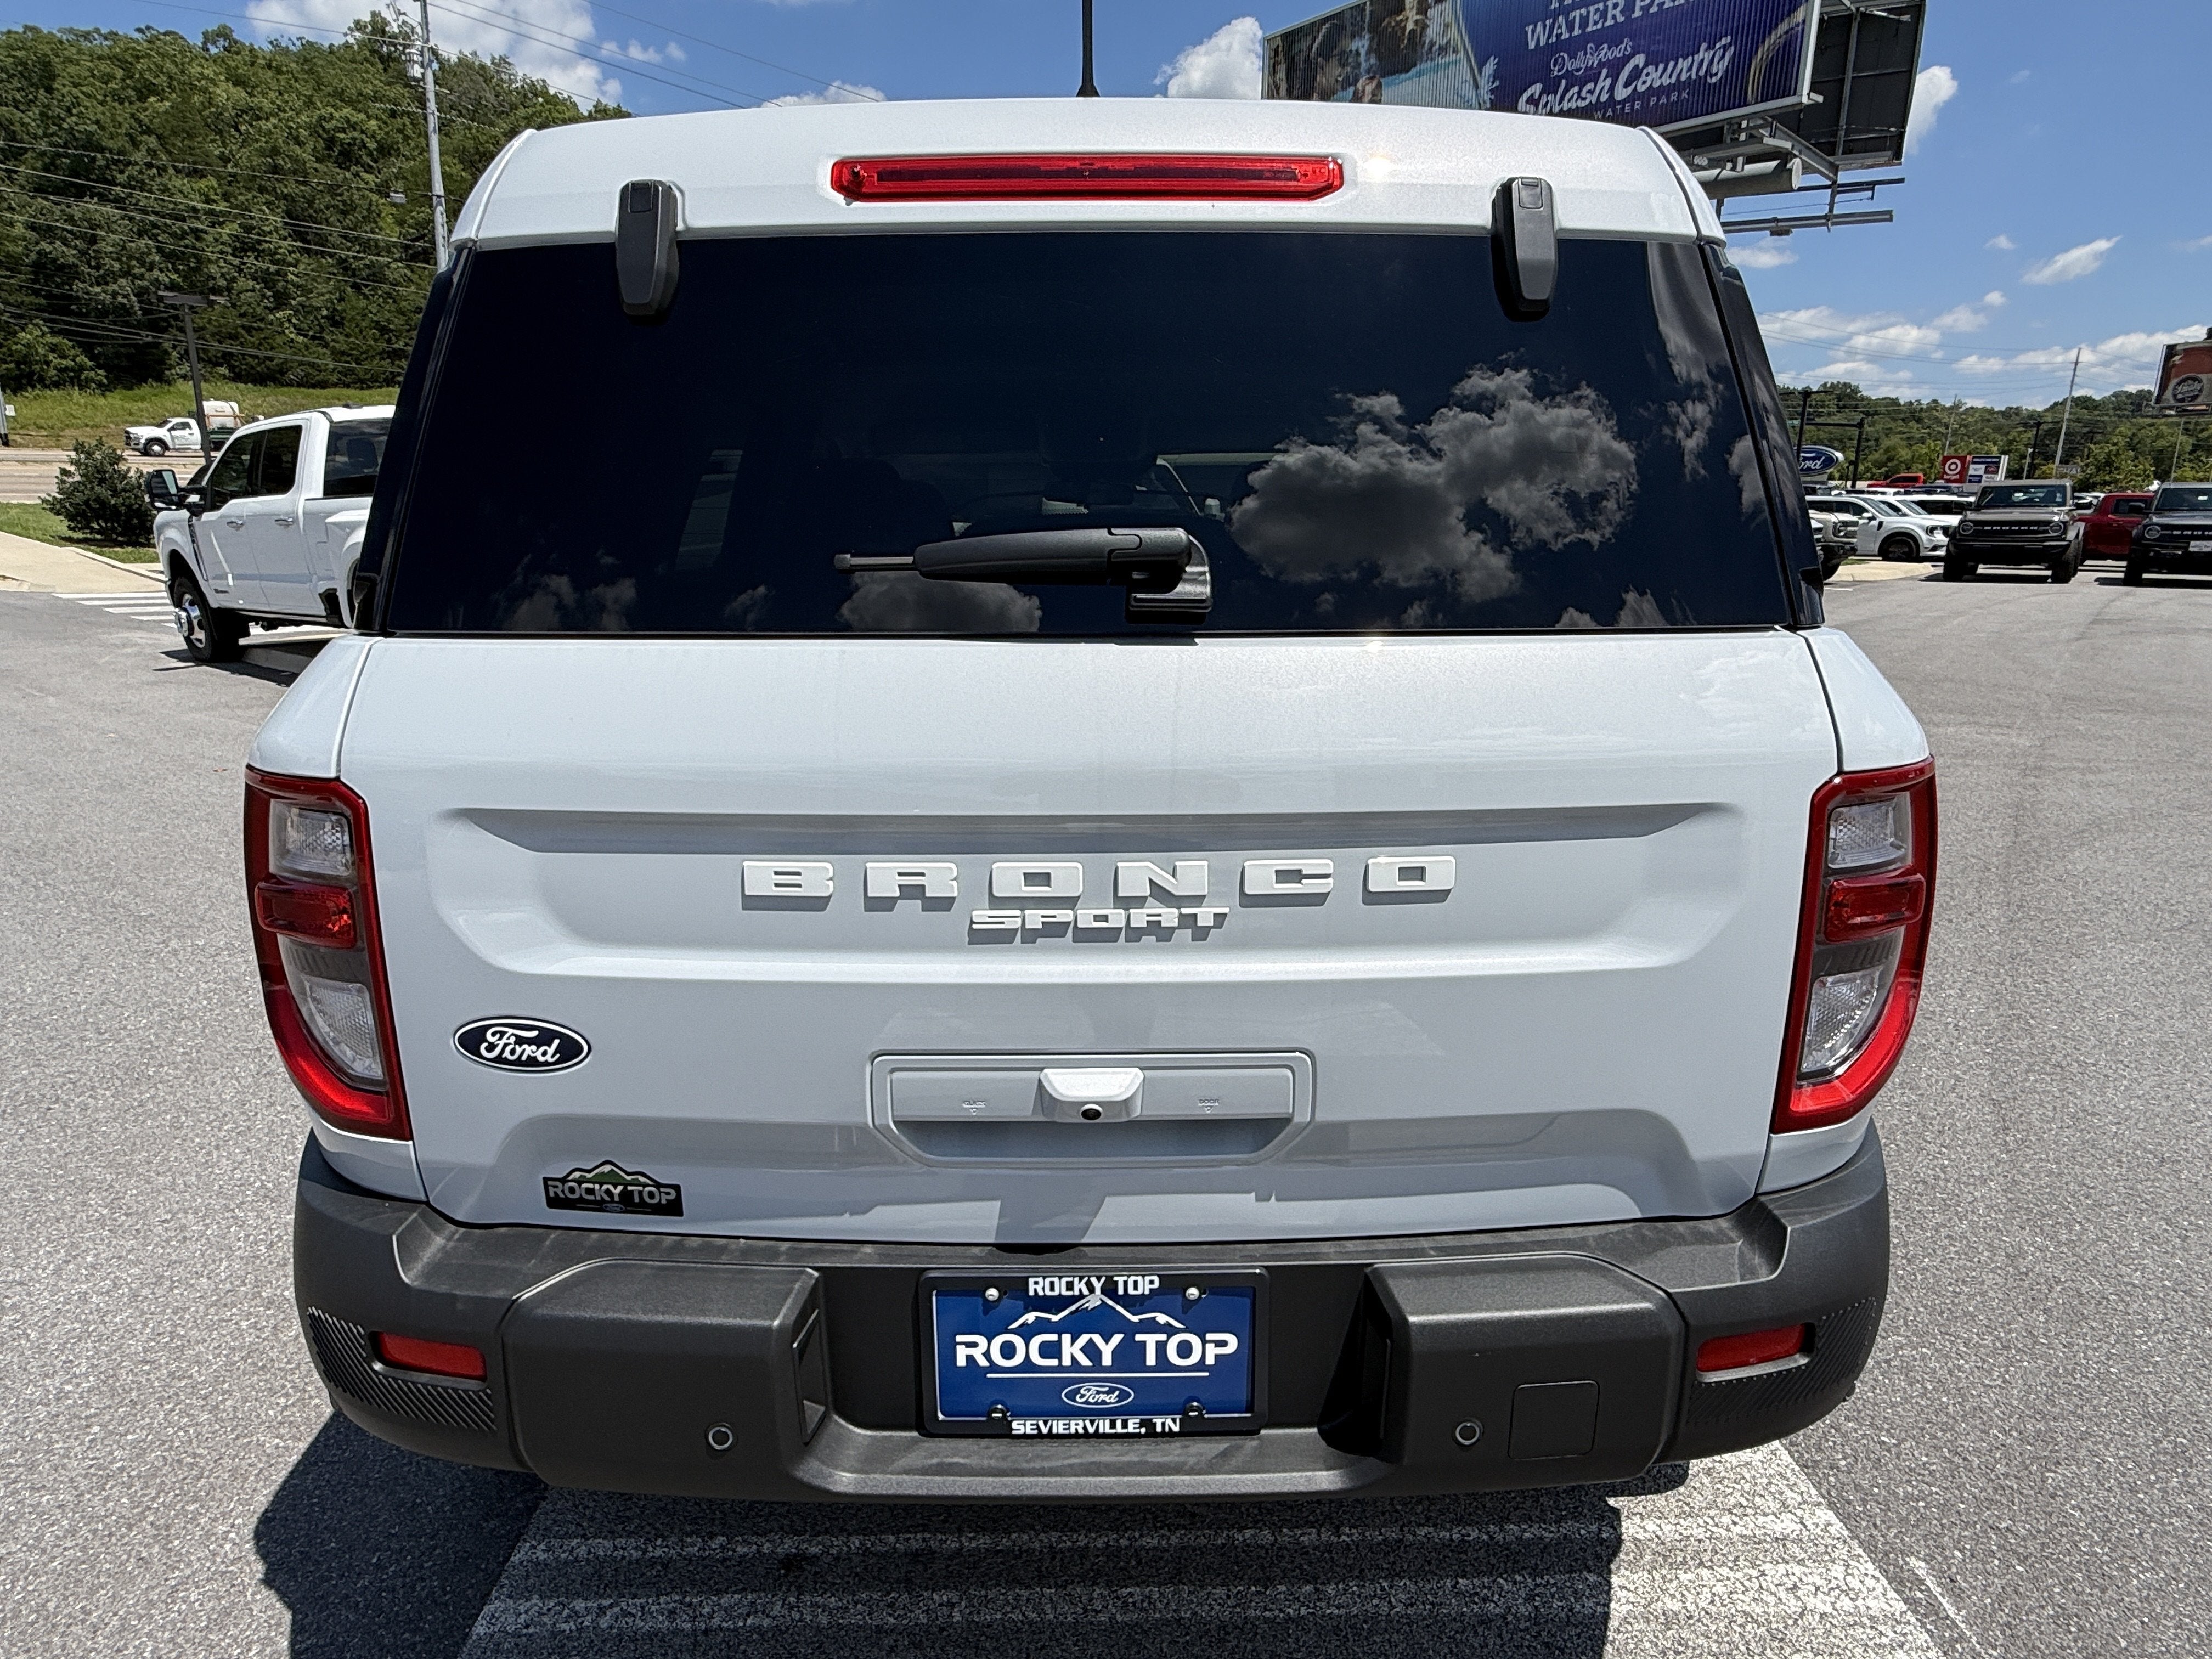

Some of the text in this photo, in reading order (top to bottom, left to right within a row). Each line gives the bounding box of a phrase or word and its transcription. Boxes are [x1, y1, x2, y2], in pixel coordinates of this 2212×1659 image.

[1525, 0, 1625, 49] WATER
[1517, 36, 1735, 115] Splash Country
[1594, 89, 1689, 120] WATER PARK
[742, 856, 1457, 898] BRONCO
[971, 907, 1230, 930] SPORT
[481, 1026, 561, 1063] Ford
[548, 1181, 676, 1204] ROCKY TOP
[1028, 1276, 1160, 1296] ROCKY TOP
[956, 1333, 1239, 1367] ROCKY TOP
[1076, 1387, 1119, 1403] Ford
[1012, 1419, 1180, 1435] SEVIERVILLE, TN
